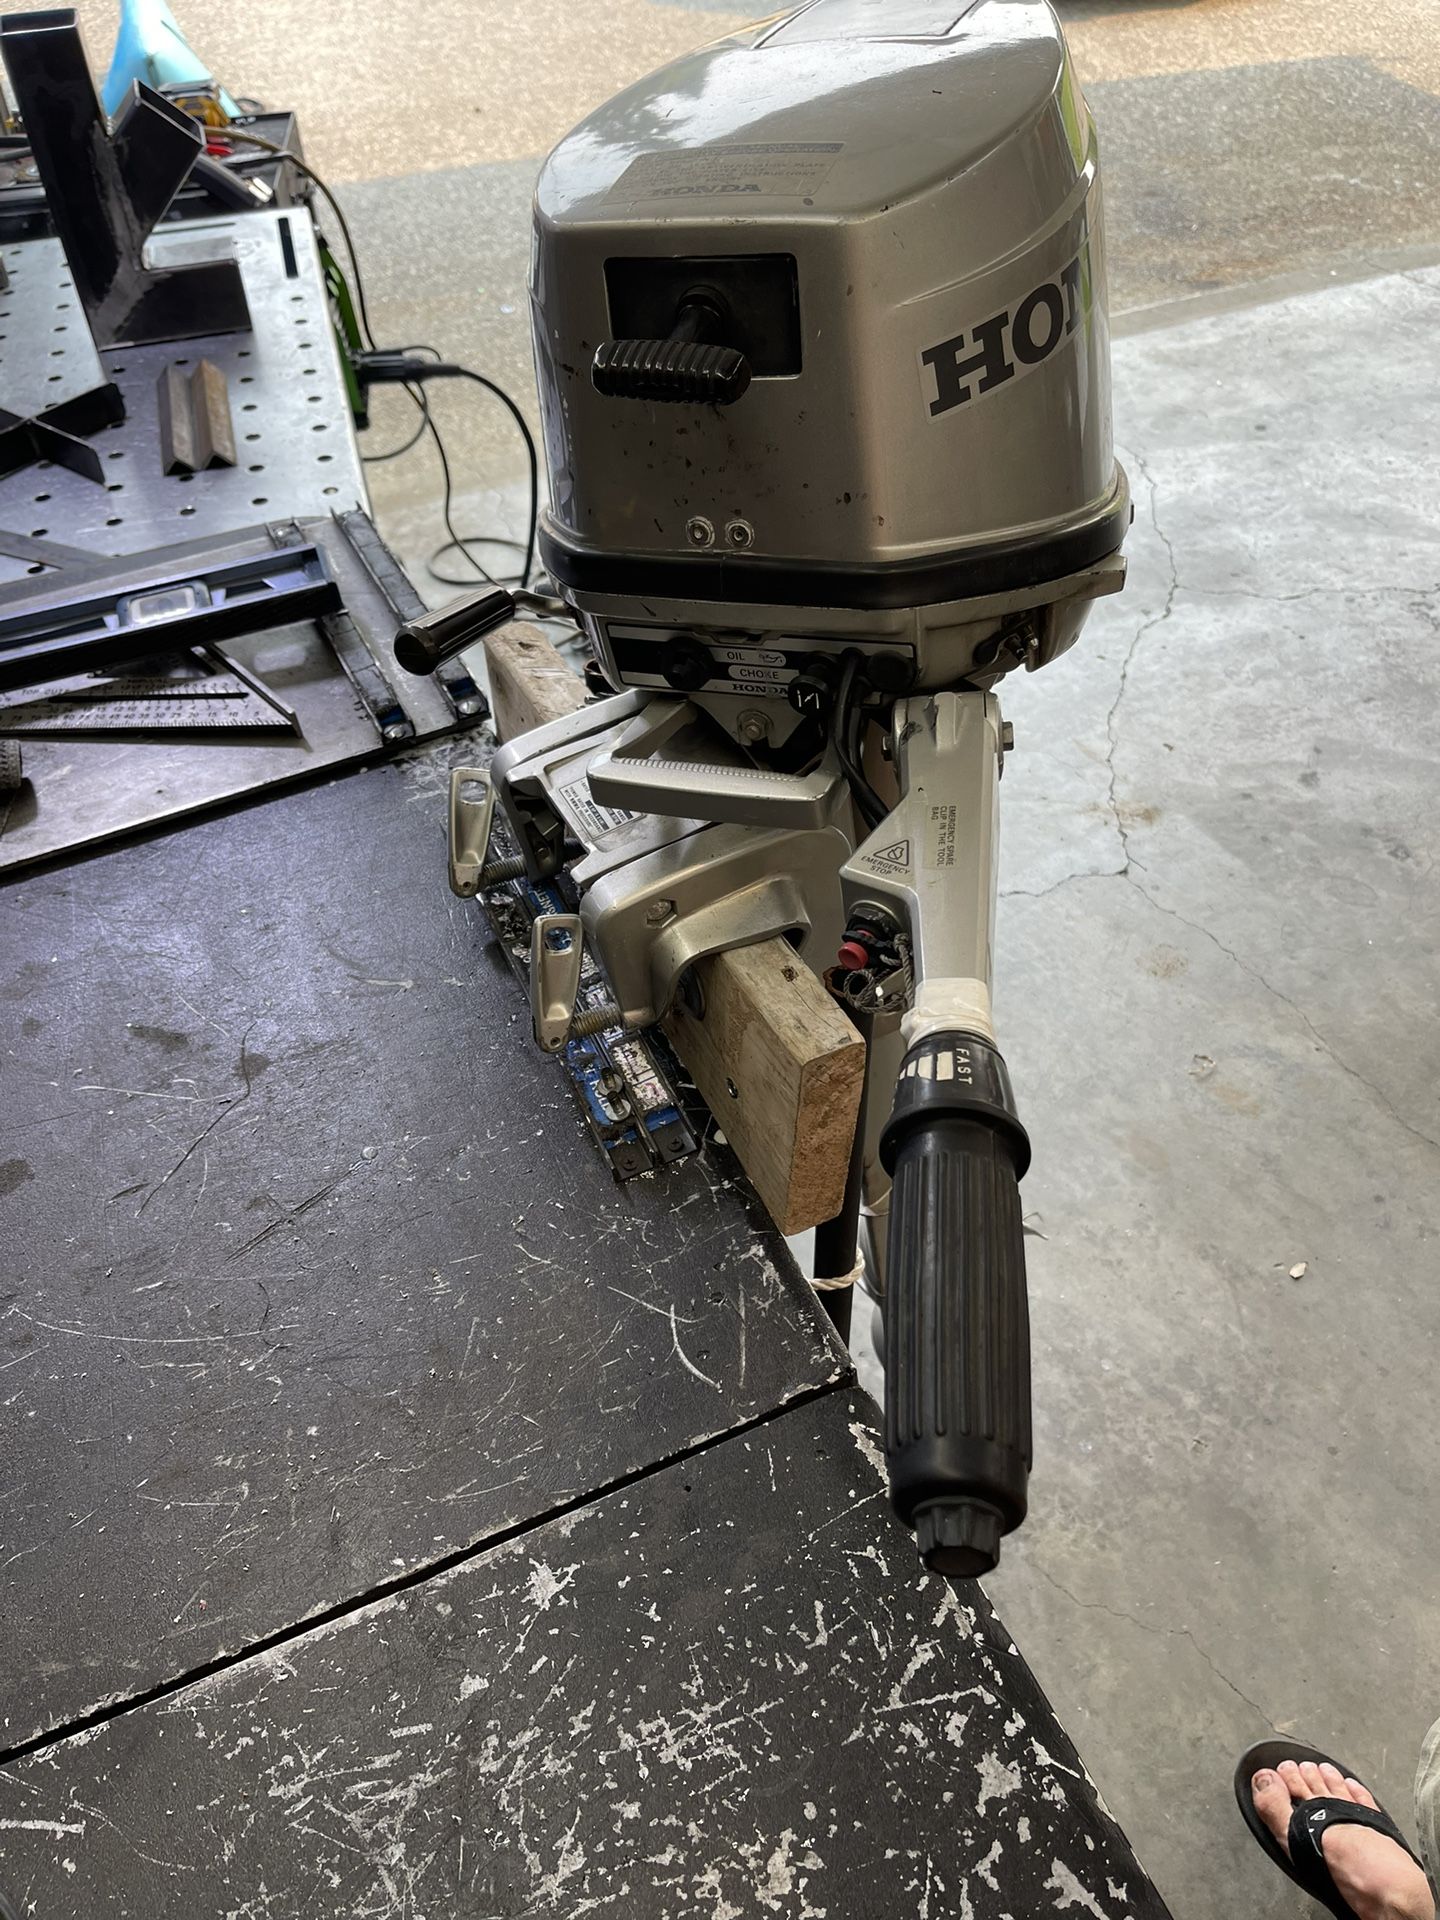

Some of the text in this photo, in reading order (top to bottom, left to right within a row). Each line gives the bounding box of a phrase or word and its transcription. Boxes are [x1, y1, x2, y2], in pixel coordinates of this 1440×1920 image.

[650, 184, 762, 196] HONDA
[726, 651, 745, 661] OIL
[931, 806, 940, 821] BAG
[936, 806, 948, 866] CLIP IN THE TOOL
[945, 805, 957, 867] EMERGENCY SPARE
[861, 855, 910, 875] EMERGENCY
[870, 865, 892, 875] STOP
[956, 1048, 973, 1085] FAST
